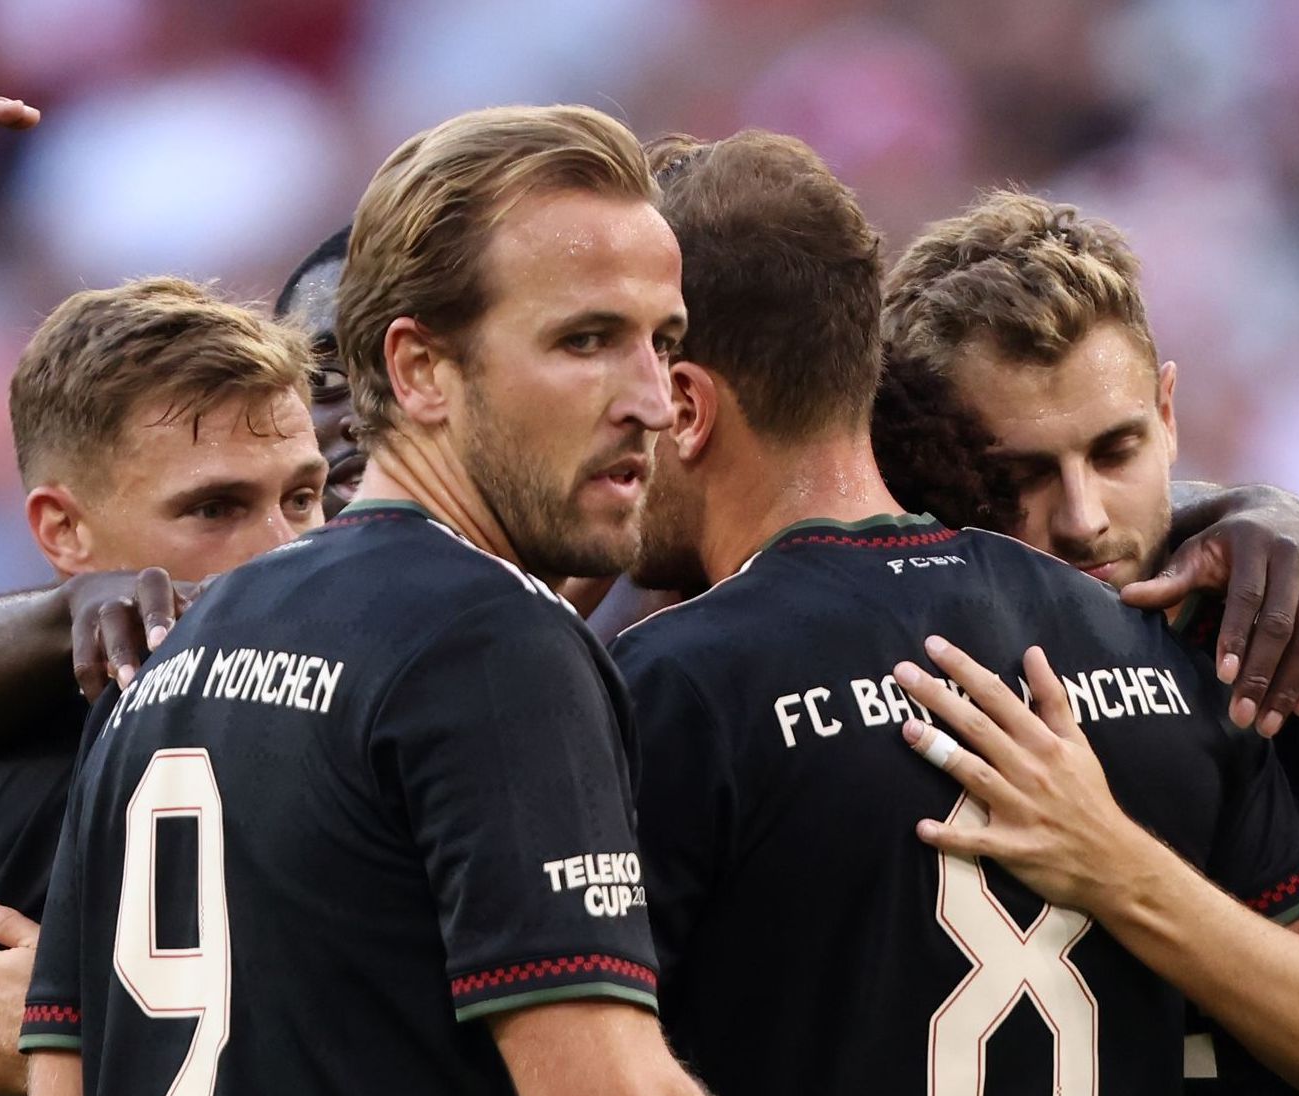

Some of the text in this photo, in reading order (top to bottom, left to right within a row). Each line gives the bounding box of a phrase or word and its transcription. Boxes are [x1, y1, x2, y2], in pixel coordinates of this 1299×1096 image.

[774, 686, 843, 748] FC
[1017, 667, 1192, 724] NCHEN
[584, 885, 648, 917] CUP 20
